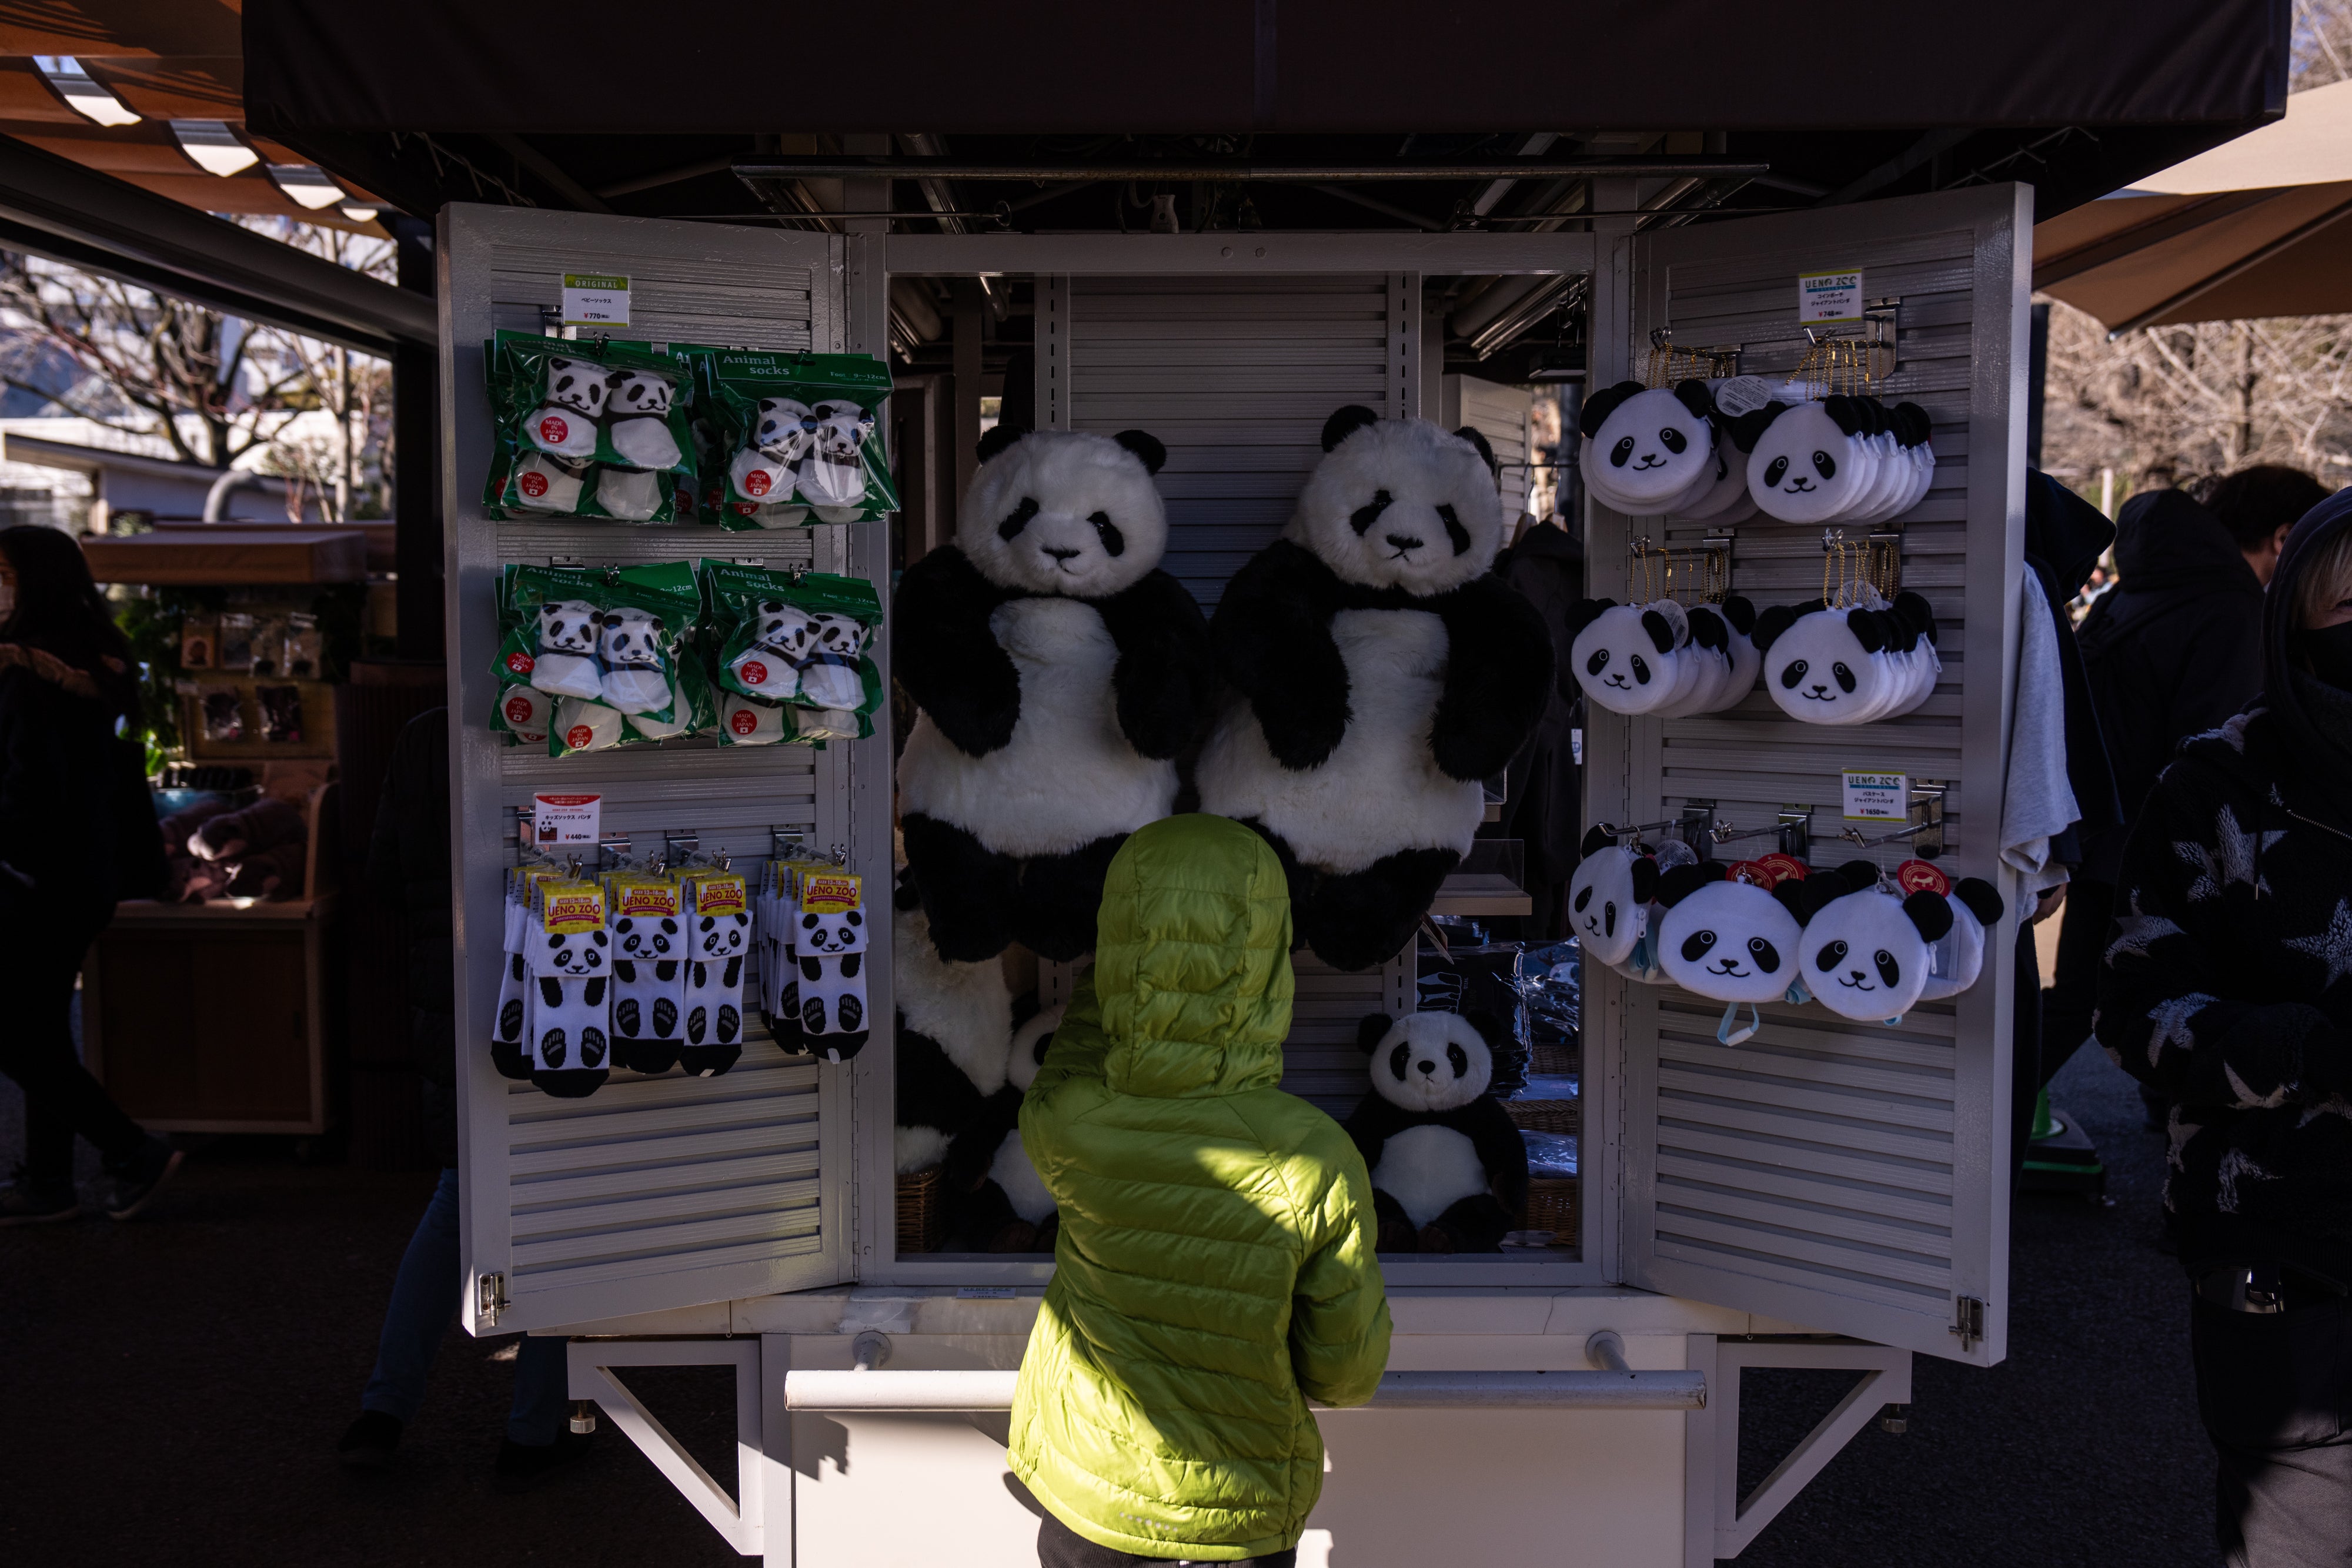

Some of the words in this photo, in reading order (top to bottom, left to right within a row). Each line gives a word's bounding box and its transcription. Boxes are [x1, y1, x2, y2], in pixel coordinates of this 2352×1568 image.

[1805, 278, 1832, 288] UENO
[1836, 276, 1857, 285] ZOO
[723, 355, 776, 365] Animal
[750, 366, 790, 375] socks
[526, 567, 581, 580] Animal
[720, 569, 771, 581] Animal
[551, 577, 593, 587] socks
[746, 581, 784, 591] socks
[516, 653, 532, 663] MADE
[512, 659, 529, 669] JAPAN
[1879, 777, 1900, 785] ZOO
[700, 891, 722, 904] UENO
[724, 889, 743, 899] ZOO
[807, 885, 833, 895] UENO
[836, 887, 857, 898] ZOO
[622, 896, 650, 907] UENO
[653, 897, 675, 907] ZOO
[548, 905, 576, 917] UENO
[579, 904, 600, 915] ZOO
